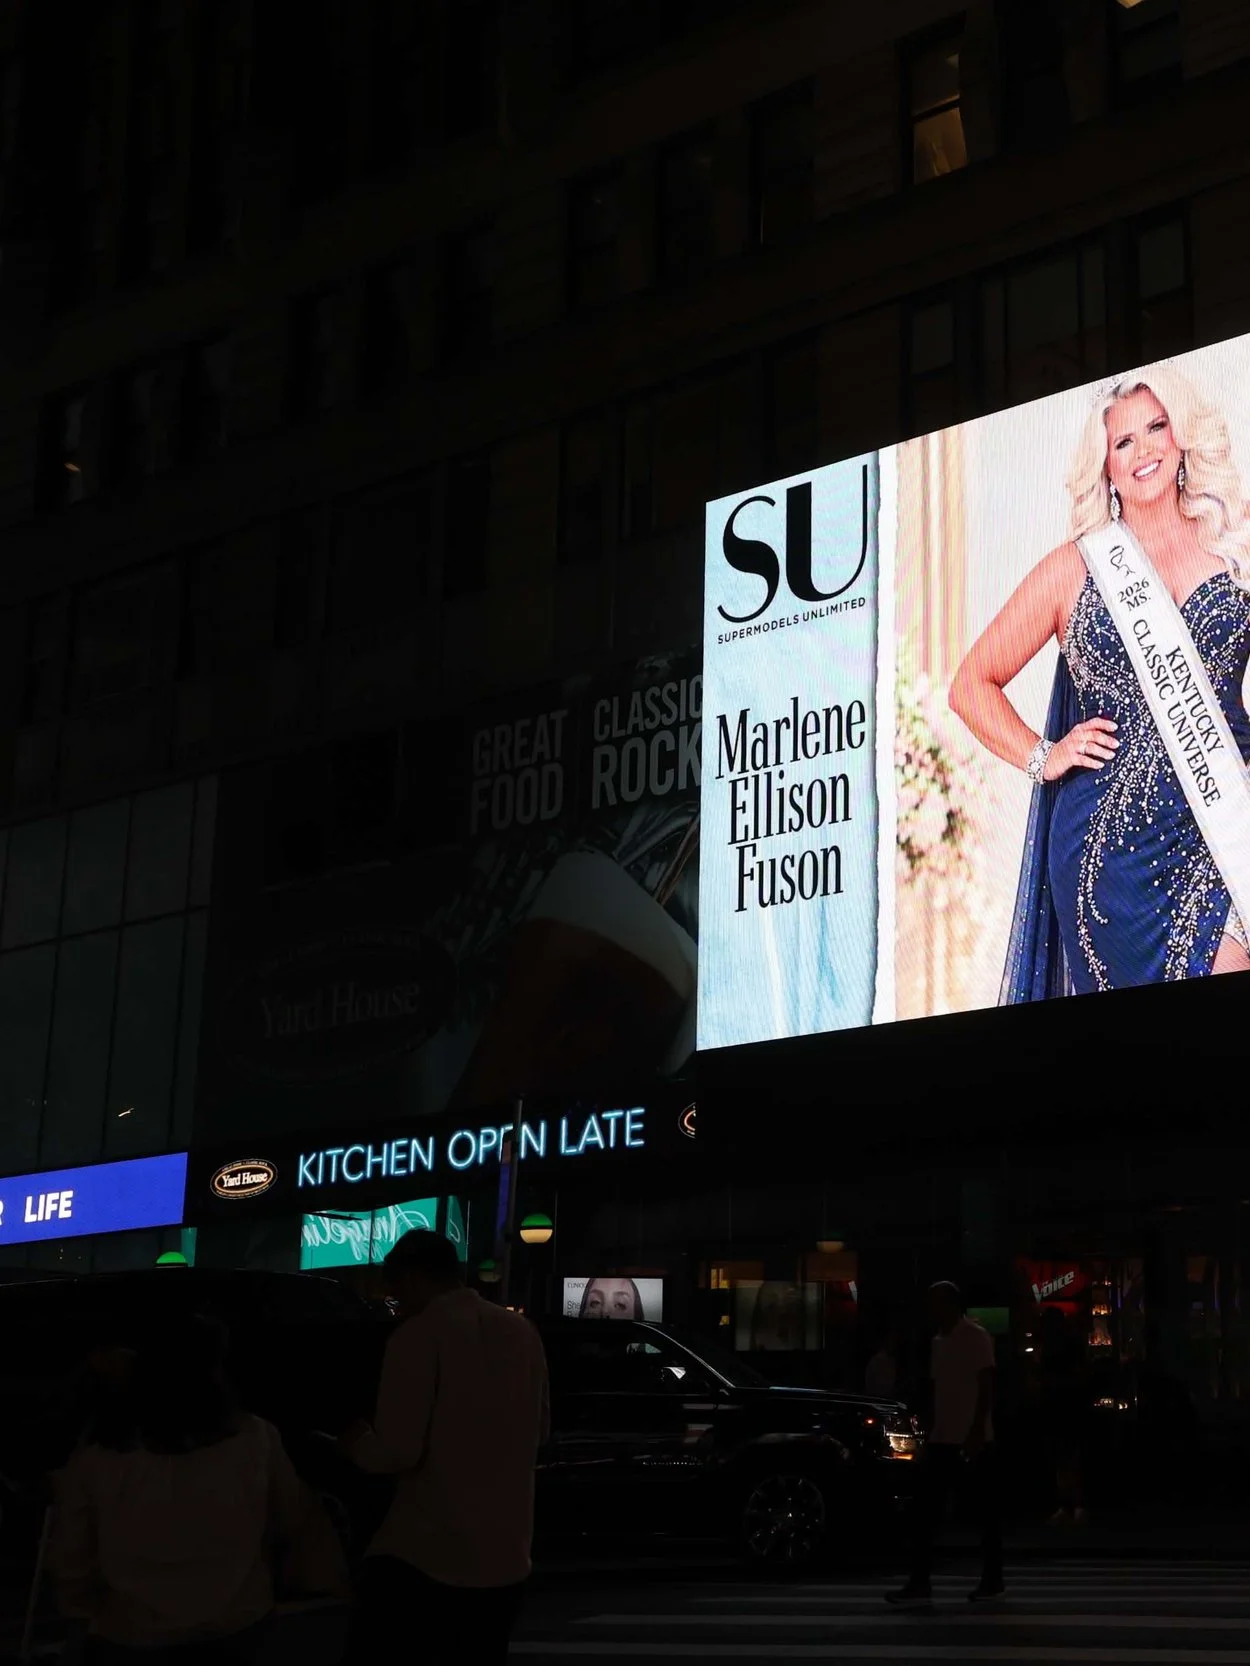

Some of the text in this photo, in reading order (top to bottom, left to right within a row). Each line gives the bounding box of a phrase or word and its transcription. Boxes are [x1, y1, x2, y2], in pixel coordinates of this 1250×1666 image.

[717, 463, 868, 624] SU
[717, 596, 867, 645] SUPERMODELS UNLIMITED
[1117, 577, 1150, 603] 2026
[593, 674, 703, 742] CLASSIC
[715, 696, 866, 779] Marlene
[1132, 618, 1221, 807] CLASSIC UNIVERSE
[1166, 645, 1224, 754] KENTUCKY
[472, 708, 569, 777] GREAT
[592, 722, 702, 810] ROCK
[469, 762, 565, 838] FOOD
[728, 769, 853, 845] Ellison
[734, 843, 844, 912] Fuson
[222, 1171, 268, 1188] Yard House
[296, 1136, 435, 1188] KITCHEN
[560, 1106, 646, 1156] LATE
[24, 1190, 74, 1223] LIFE
